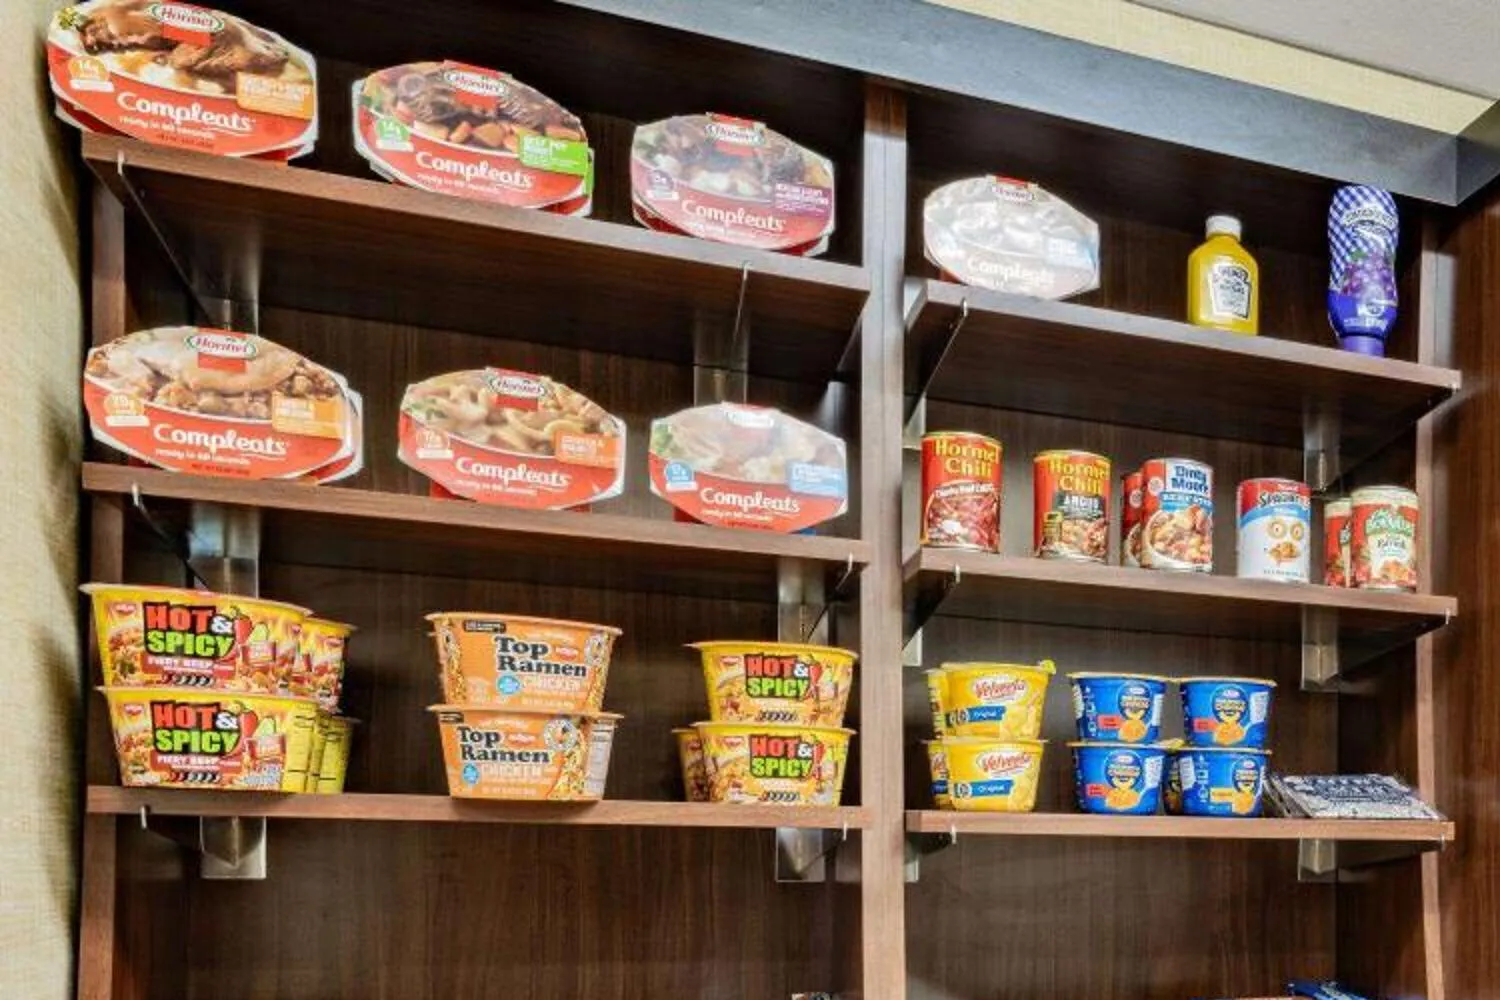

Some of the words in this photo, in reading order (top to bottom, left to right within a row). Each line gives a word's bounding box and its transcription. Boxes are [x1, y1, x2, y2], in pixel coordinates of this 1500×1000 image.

[116, 91, 253, 132] Compleats
[415, 151, 534, 188] Compleats
[681, 201, 785, 231] Compleats
[196, 337, 248, 353] Hormel
[153, 423, 287, 454] Compleats
[455, 456, 572, 487] Compleats
[944, 458, 993, 479] Chili
[1060, 475, 1103, 495] Chili
[700, 486, 801, 513] Compleats
[144, 604, 213, 632] HOT
[211, 616, 233, 634] &
[146, 631, 235, 657] SPICY
[494, 637, 549, 659] Top
[497, 655, 588, 676] Ramen
[745, 655, 797, 678] HOT
[793, 664, 810, 678] &
[746, 677, 810, 697] SPICY
[972, 679, 1026, 697] Velveeta
[153, 703, 218, 730] HOT
[216, 713, 238, 730] &
[156, 730, 240, 755] SPICY
[458, 726, 501, 750] Top
[750, 736, 800, 758] HOT
[797, 744, 813, 758] &
[460, 744, 550, 763] Ramen
[750, 757, 812, 778] SPICY
